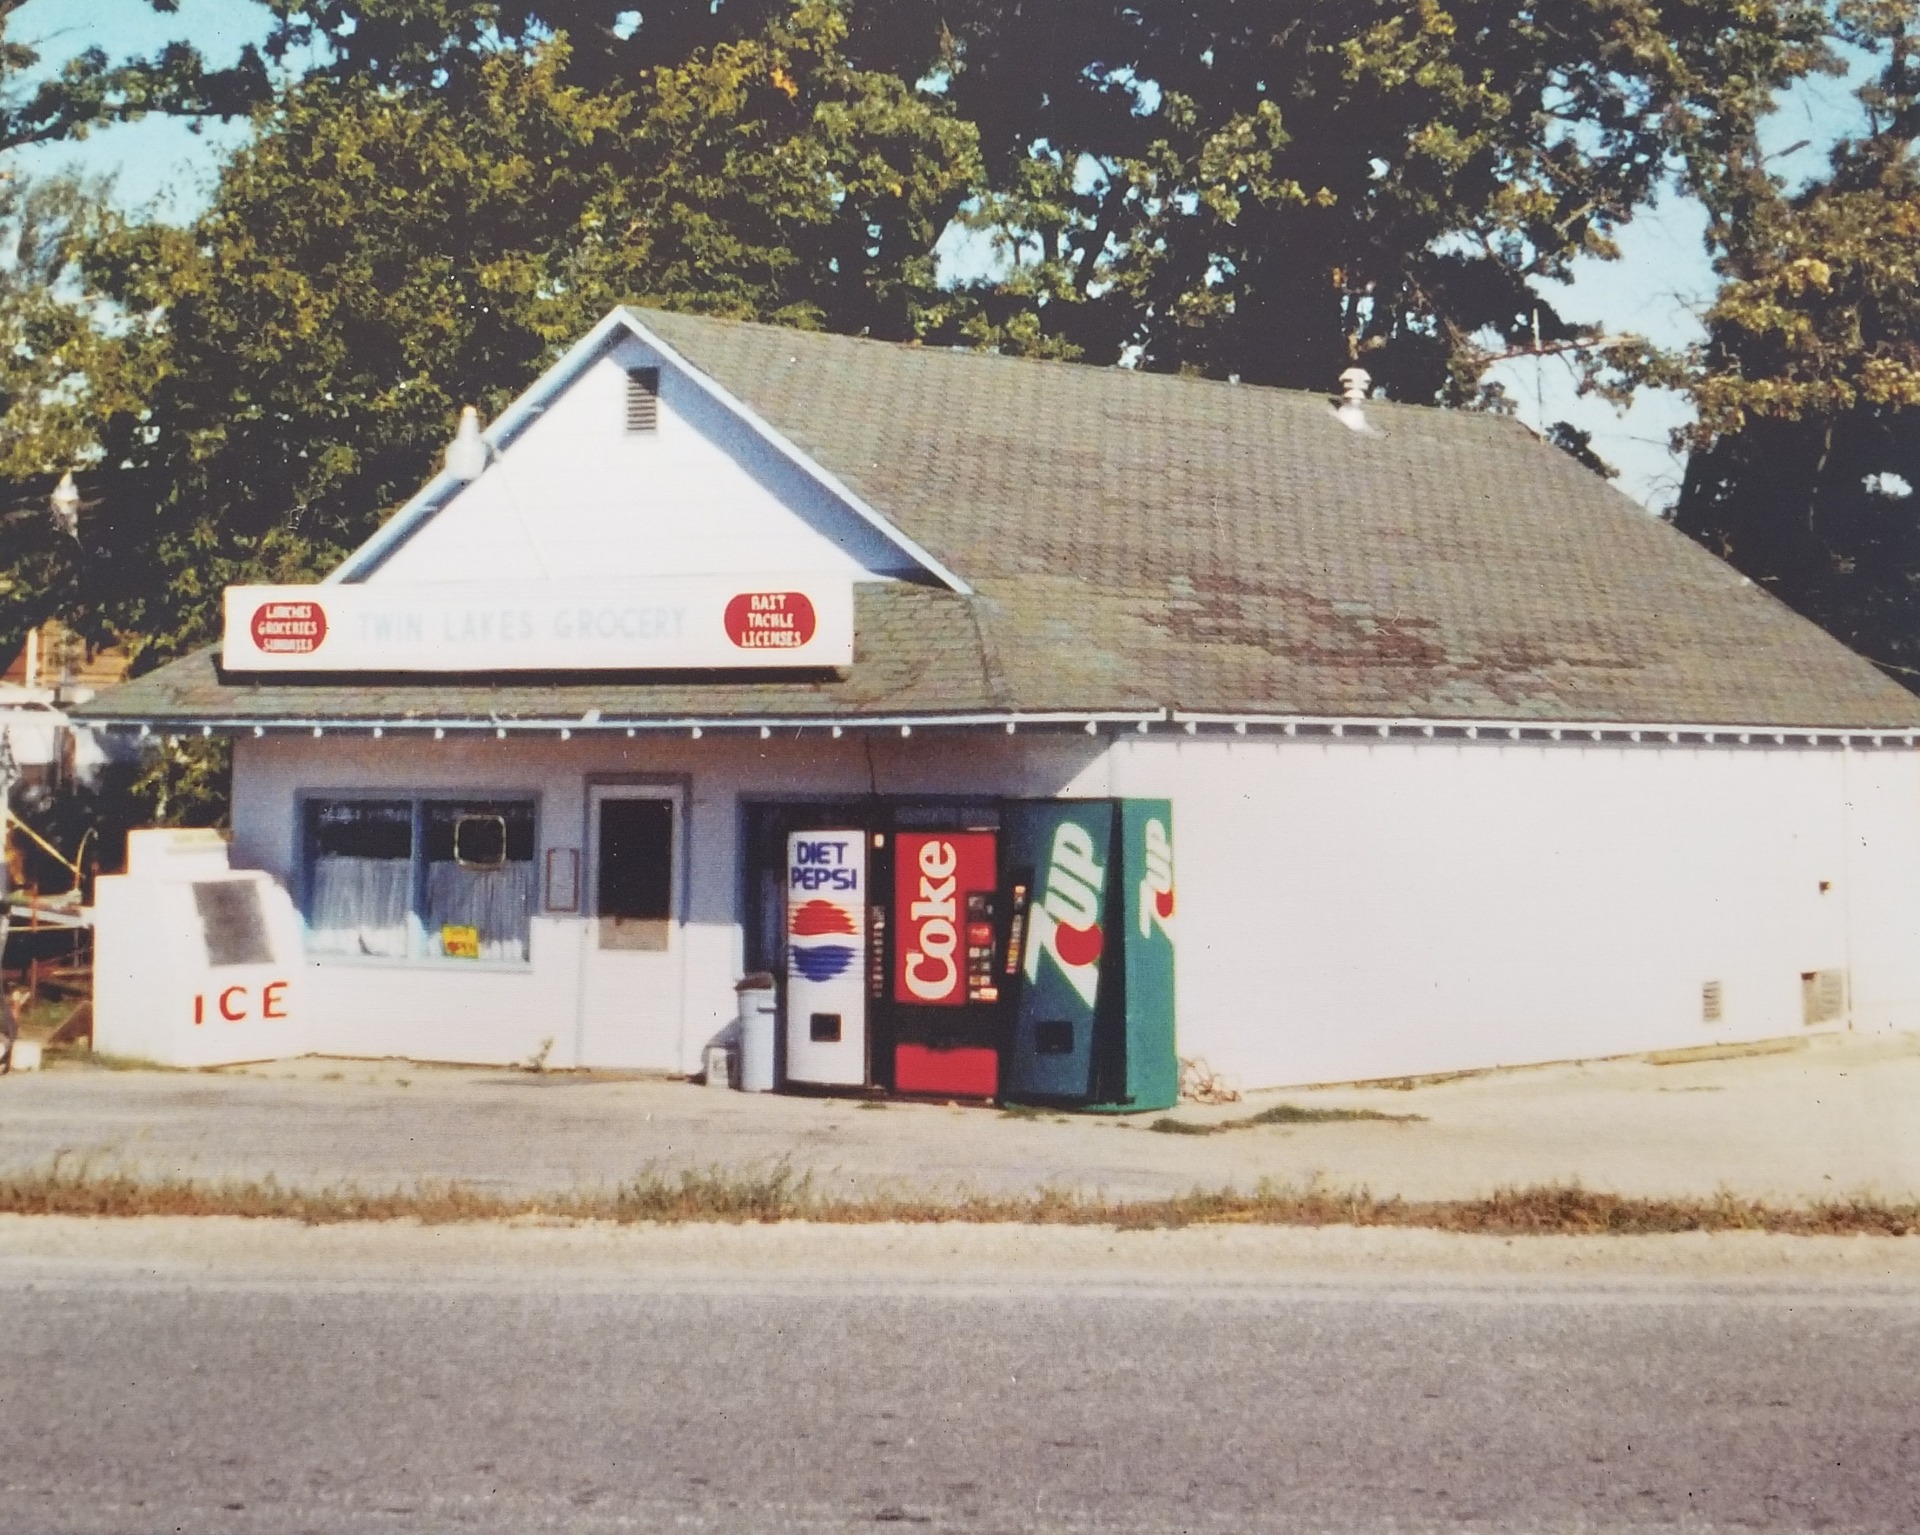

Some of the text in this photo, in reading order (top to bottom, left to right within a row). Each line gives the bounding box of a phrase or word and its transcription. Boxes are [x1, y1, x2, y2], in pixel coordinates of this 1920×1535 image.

[357, 607, 688, 641] TWIN LAKES GROCERY
[747, 613, 794, 628] TACKLE
[741, 630, 802, 647] LICENSES
[796, 840, 850, 866] DIET
[791, 868, 857, 890] PEPSI
[904, 840, 958, 1000] Coke
[1022, 821, 1106, 1009] 7UP
[193, 981, 290, 1026] ICE
